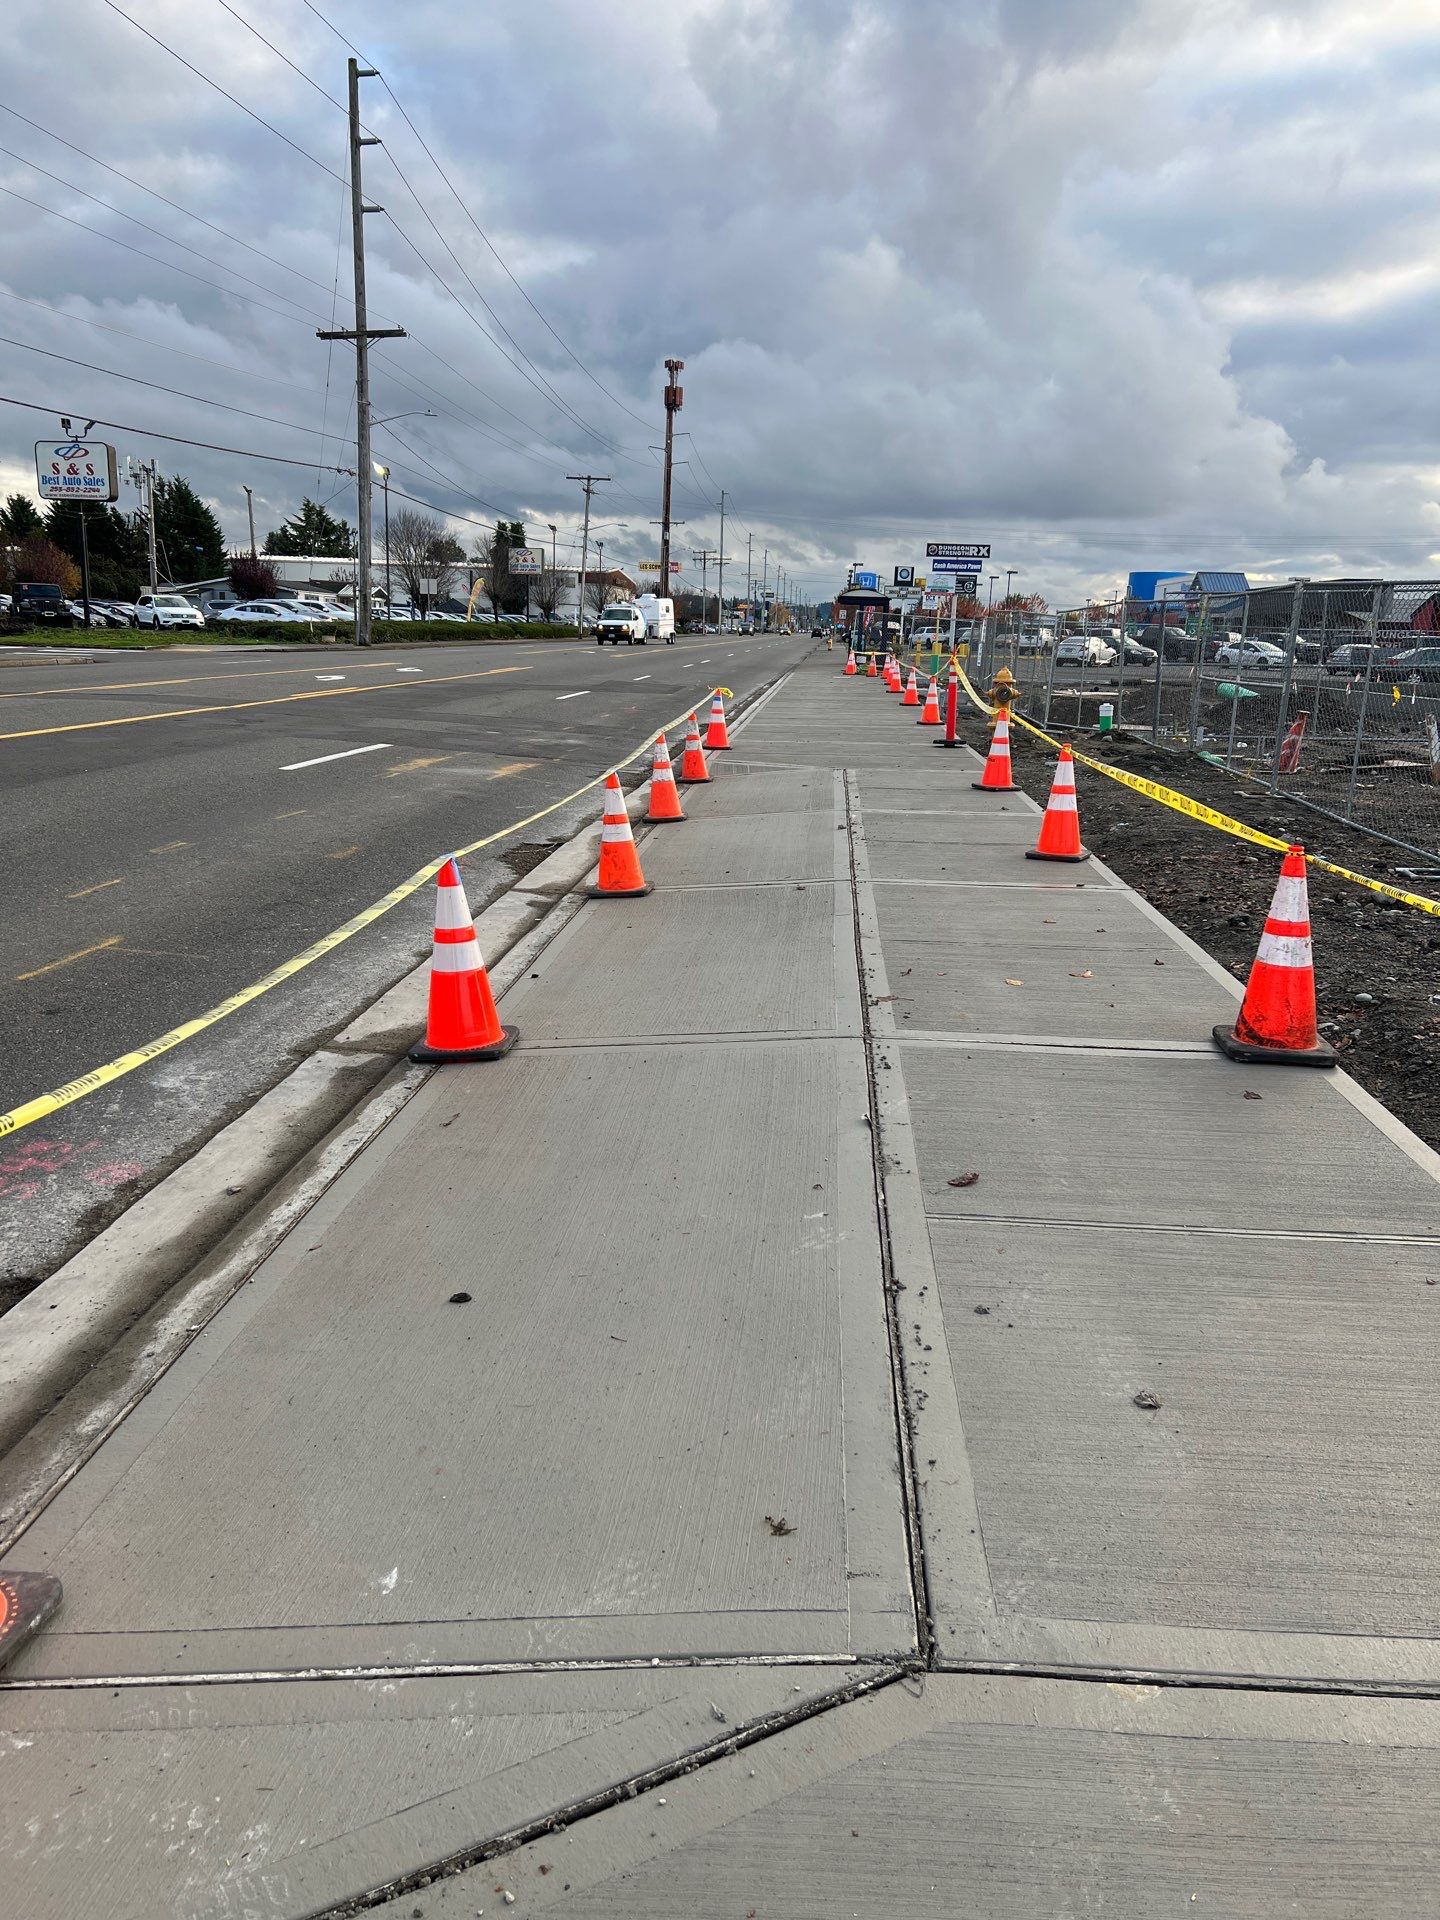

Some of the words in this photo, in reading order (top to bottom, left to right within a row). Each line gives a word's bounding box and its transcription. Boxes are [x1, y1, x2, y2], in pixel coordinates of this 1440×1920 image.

[52, 463, 60, 475] S
[66, 463, 80, 475] &
[85, 463, 95, 476] S
[41, 475, 60, 485] Best
[62, 476, 81, 486] Auto
[83, 476, 105, 487] Sales
[969, 546, 989, 557] RX
